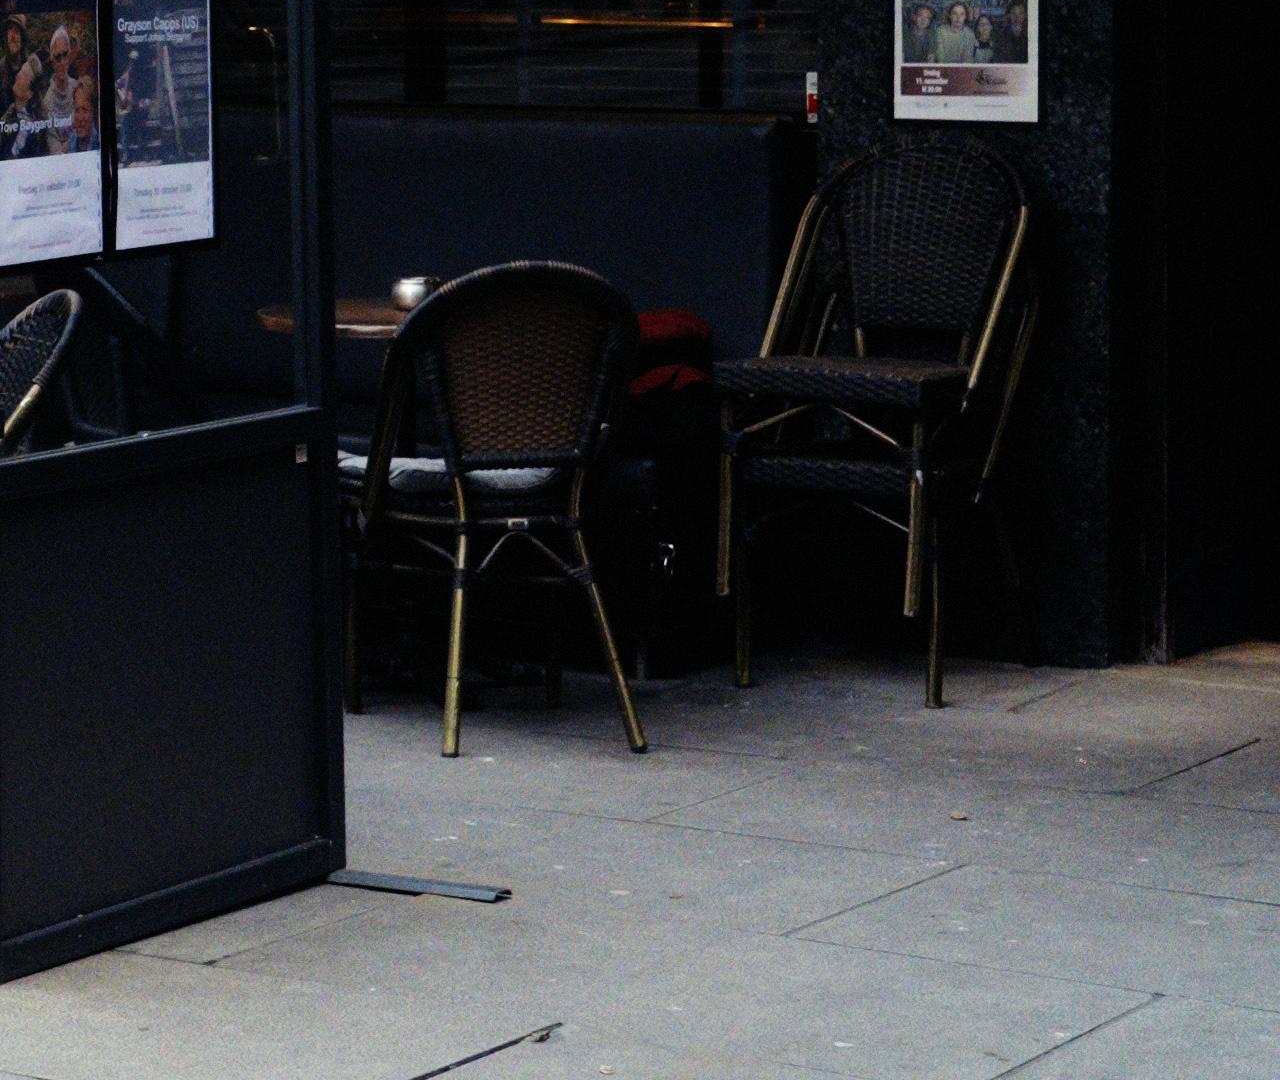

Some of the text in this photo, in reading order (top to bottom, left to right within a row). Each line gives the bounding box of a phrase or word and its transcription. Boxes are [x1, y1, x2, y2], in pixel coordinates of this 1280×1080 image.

[117, 15, 199, 34] Grayson Capps (US)
[0, 120, 19, 133] Tove
